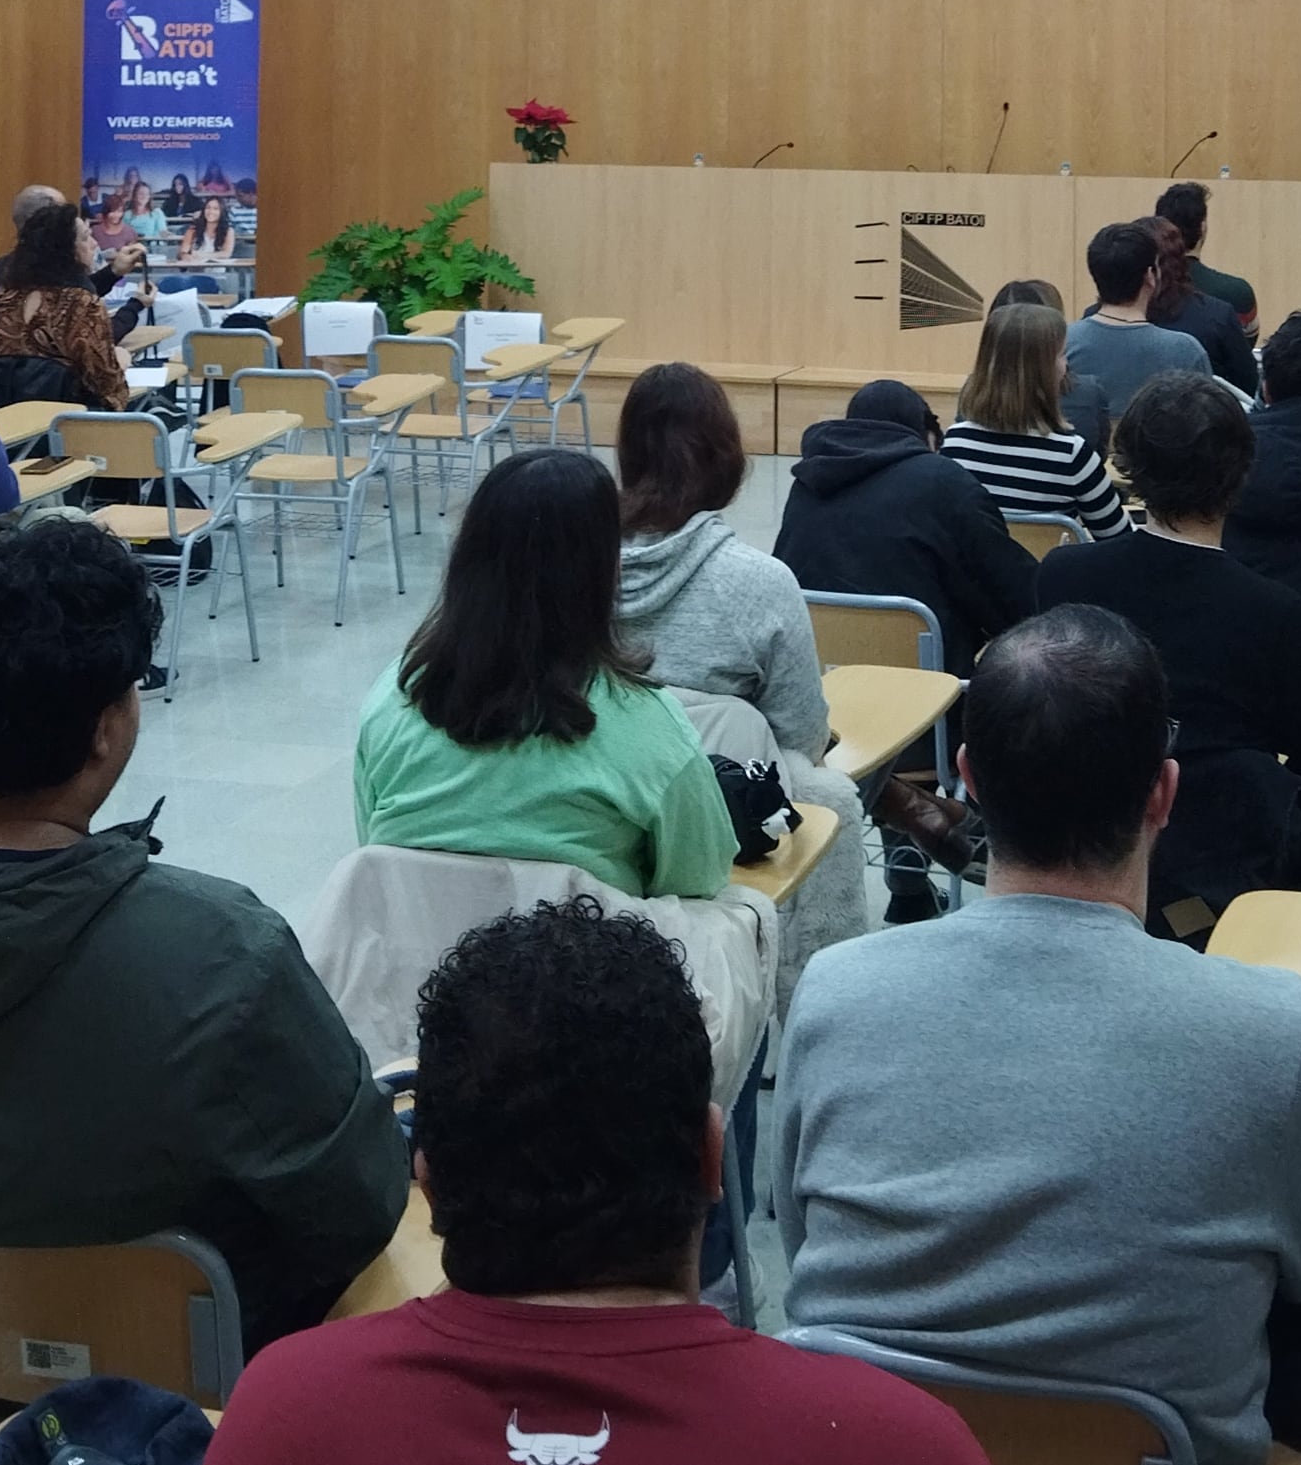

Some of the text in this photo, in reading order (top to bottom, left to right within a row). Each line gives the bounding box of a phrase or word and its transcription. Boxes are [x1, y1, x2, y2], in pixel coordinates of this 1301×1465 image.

[163, 23, 214, 37] CIPFP
[107, 116, 234, 128] VIVER D'EMPRESA
[902, 212, 985, 226] CIP FP BATOI
